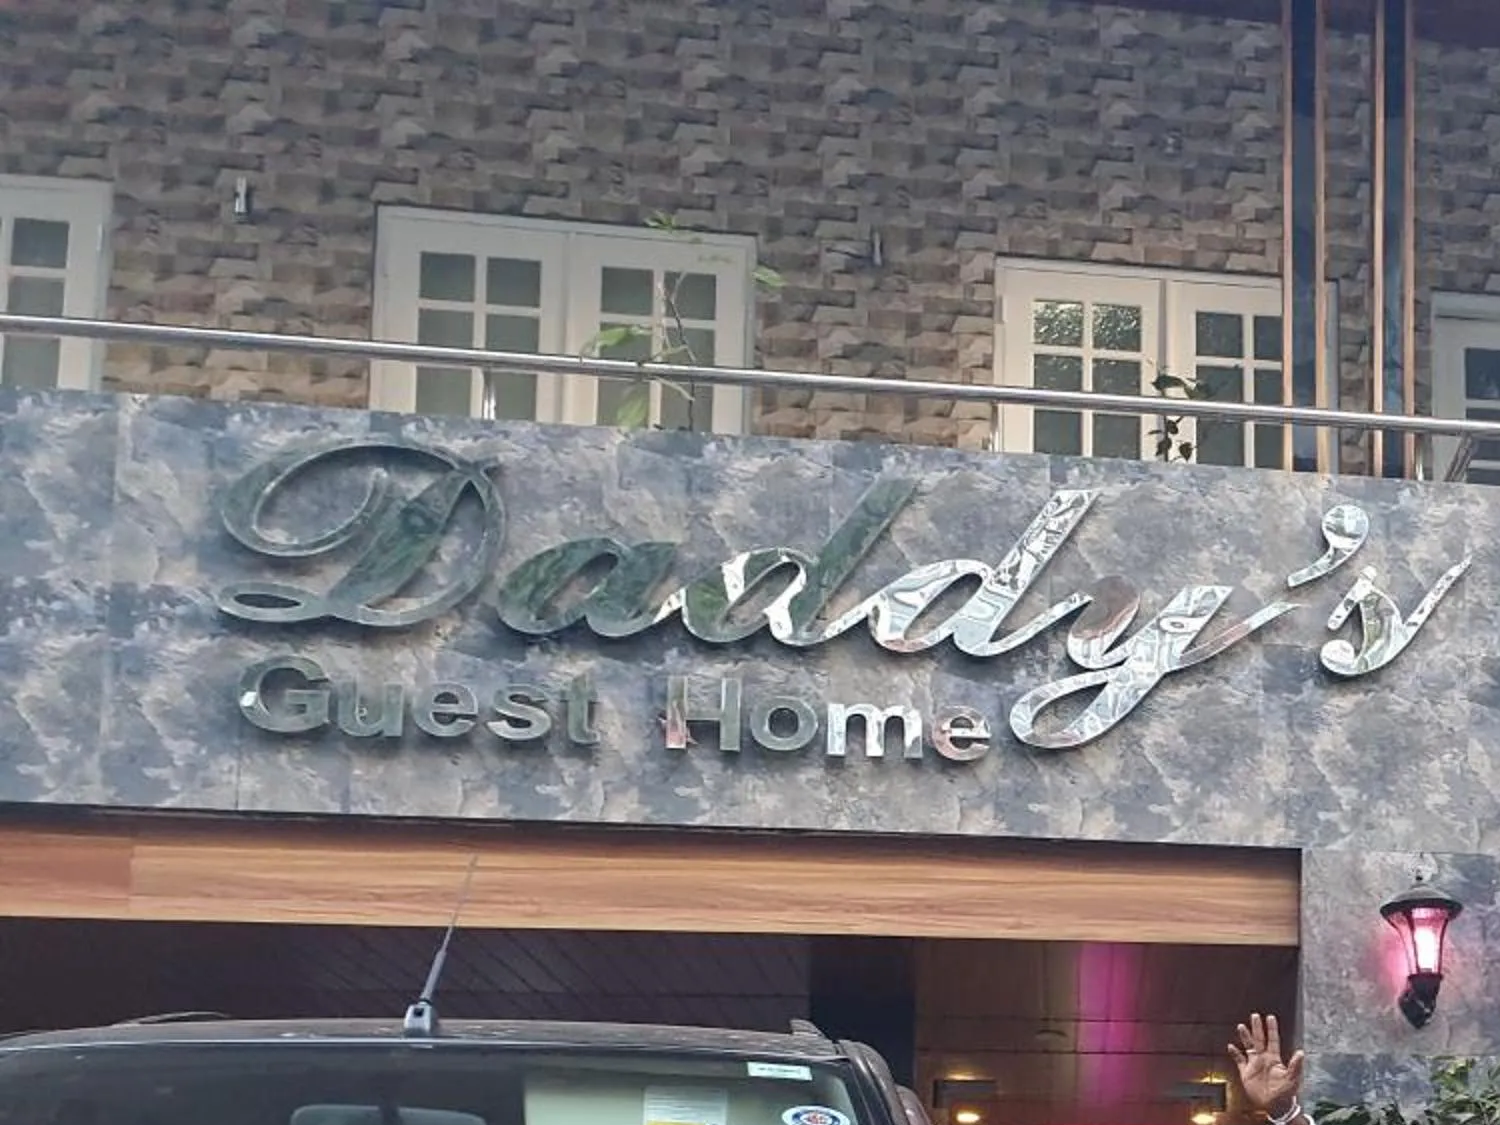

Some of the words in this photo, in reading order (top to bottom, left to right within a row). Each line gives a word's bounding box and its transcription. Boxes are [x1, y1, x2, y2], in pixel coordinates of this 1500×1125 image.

[217, 443, 1474, 750] Daddy's
[238, 654, 600, 747] Guest
[663, 671, 992, 762] Home
